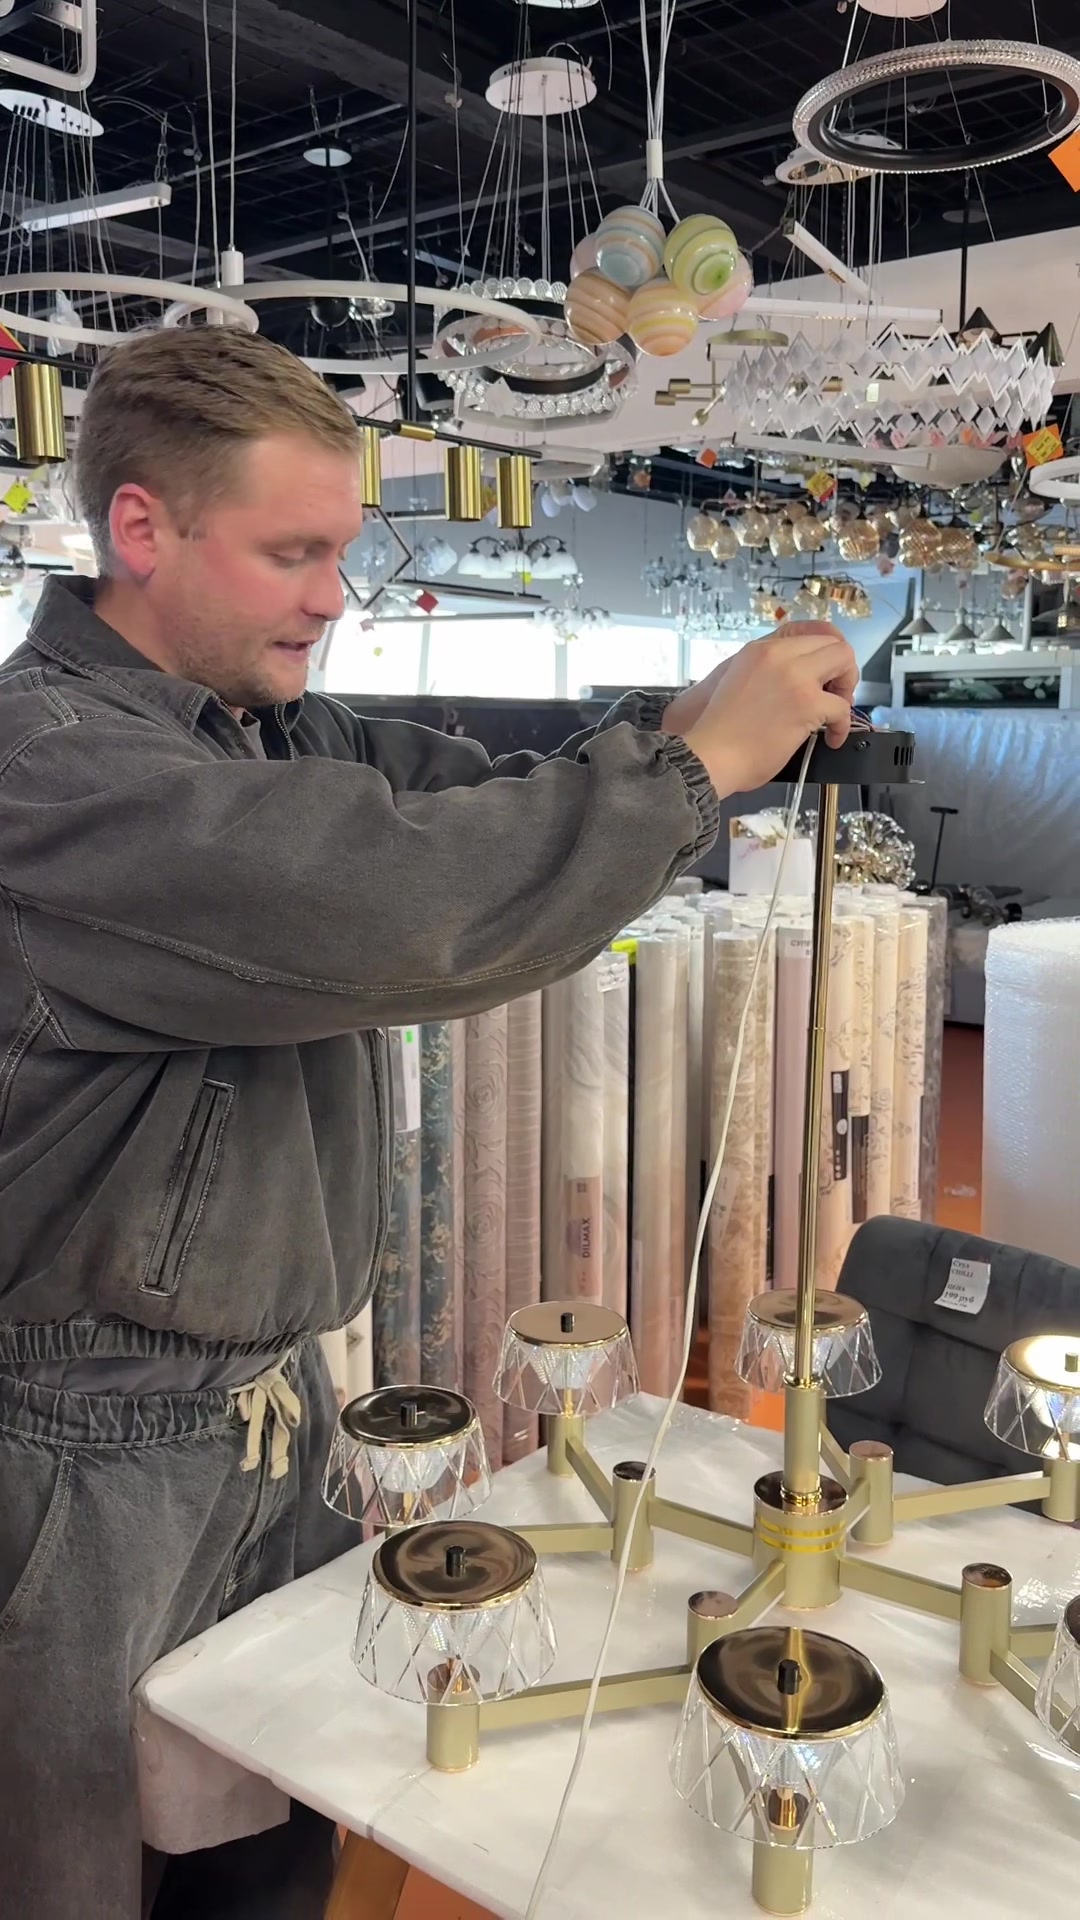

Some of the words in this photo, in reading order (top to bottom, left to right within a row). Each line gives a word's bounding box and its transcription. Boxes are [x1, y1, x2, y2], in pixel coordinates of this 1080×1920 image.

[583, 1218, 591, 1258] DILMAX
[952, 1269, 973, 1277] CHILLI
[944, 1291, 958, 1299] 199
